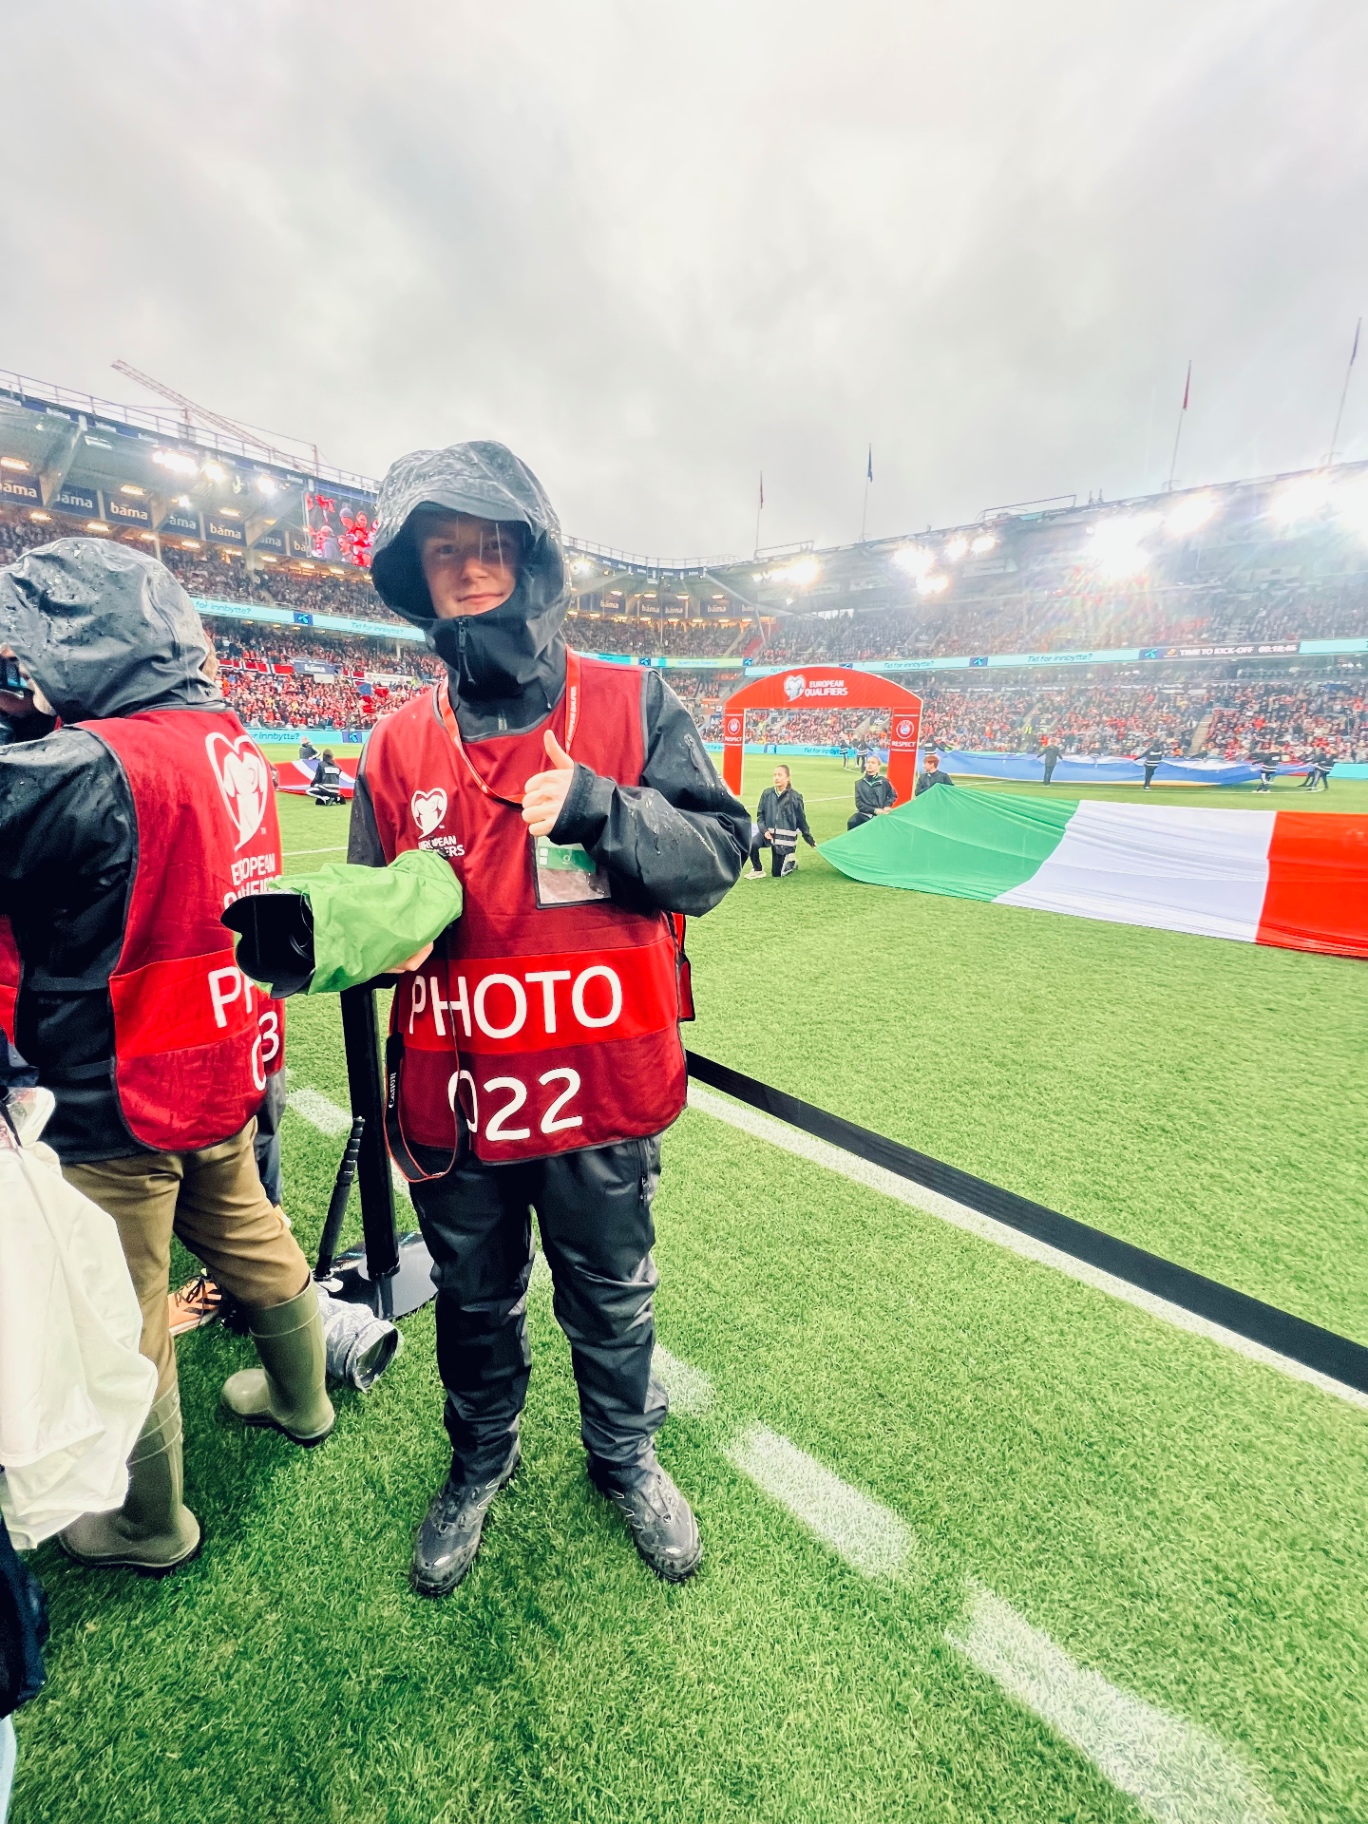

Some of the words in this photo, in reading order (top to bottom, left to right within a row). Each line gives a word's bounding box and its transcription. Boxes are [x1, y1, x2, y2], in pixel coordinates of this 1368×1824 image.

[804, 687, 848, 698] QUALIFIERS
[809, 680, 845, 688] EUROPEAN
[409, 965, 623, 1039] PHOTO
[448, 1067, 583, 1142] 022
